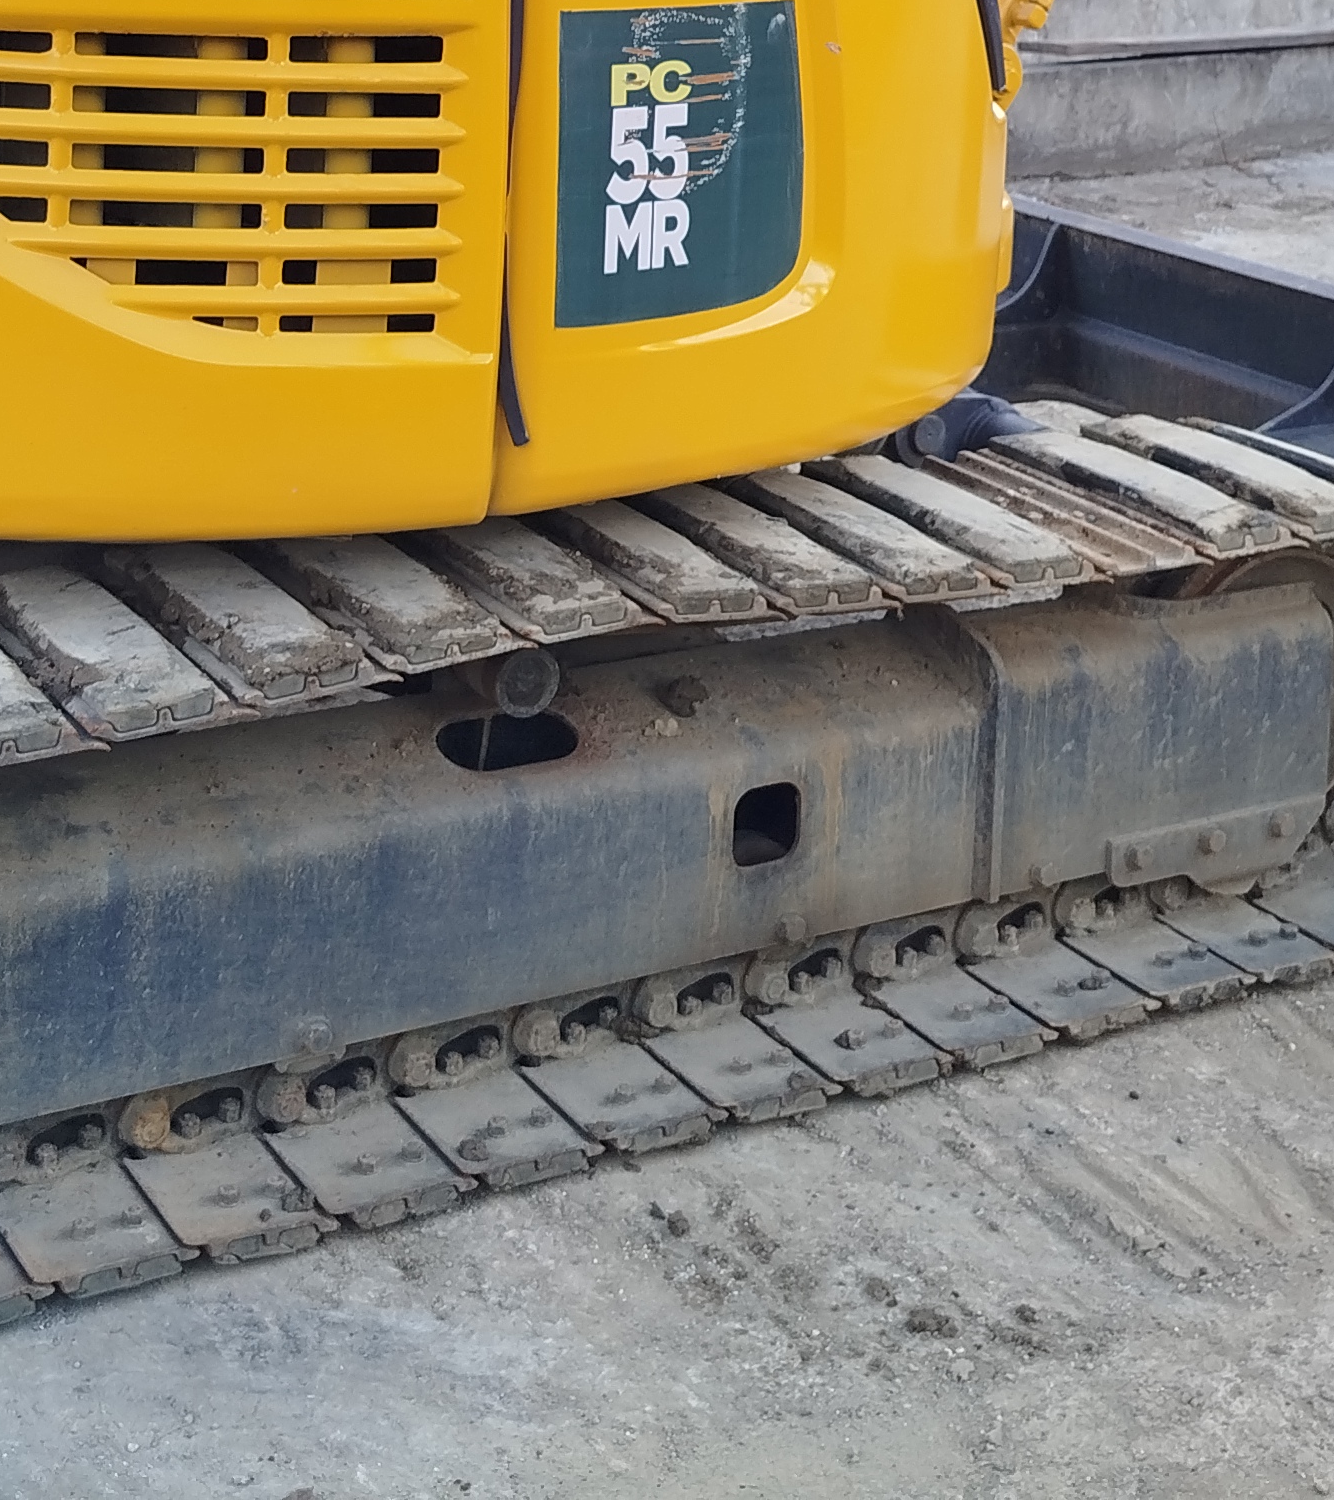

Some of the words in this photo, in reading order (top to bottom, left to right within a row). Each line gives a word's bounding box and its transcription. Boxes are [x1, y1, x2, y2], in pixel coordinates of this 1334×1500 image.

[610, 59, 693, 107] PC
[605, 102, 689, 205] 55
[603, 198, 691, 275] MR
